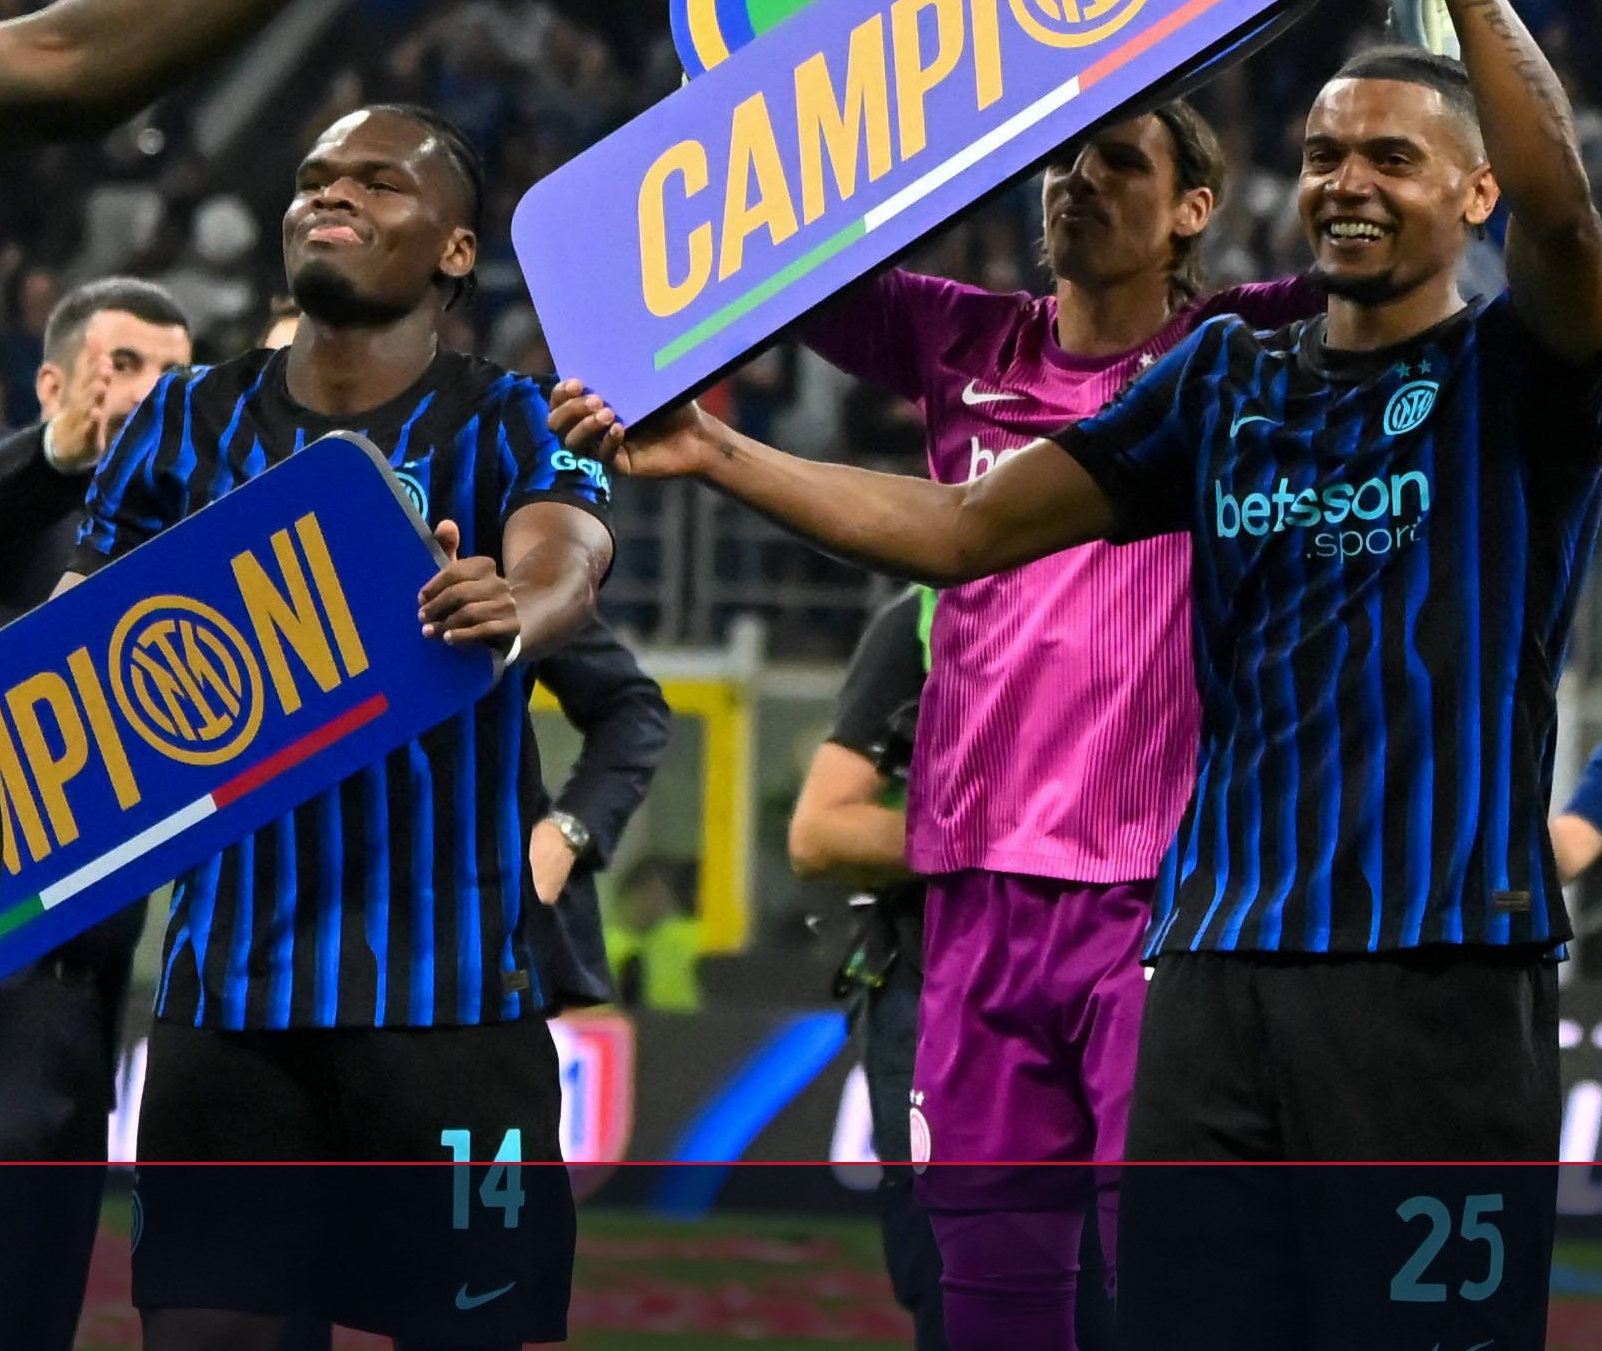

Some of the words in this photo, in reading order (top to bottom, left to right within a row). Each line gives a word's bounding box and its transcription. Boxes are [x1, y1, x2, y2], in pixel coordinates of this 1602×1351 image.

[1214, 469, 1431, 540] betsson
[440, 1127, 526, 1231] 14
[1389, 1193, 1506, 1304] 25
